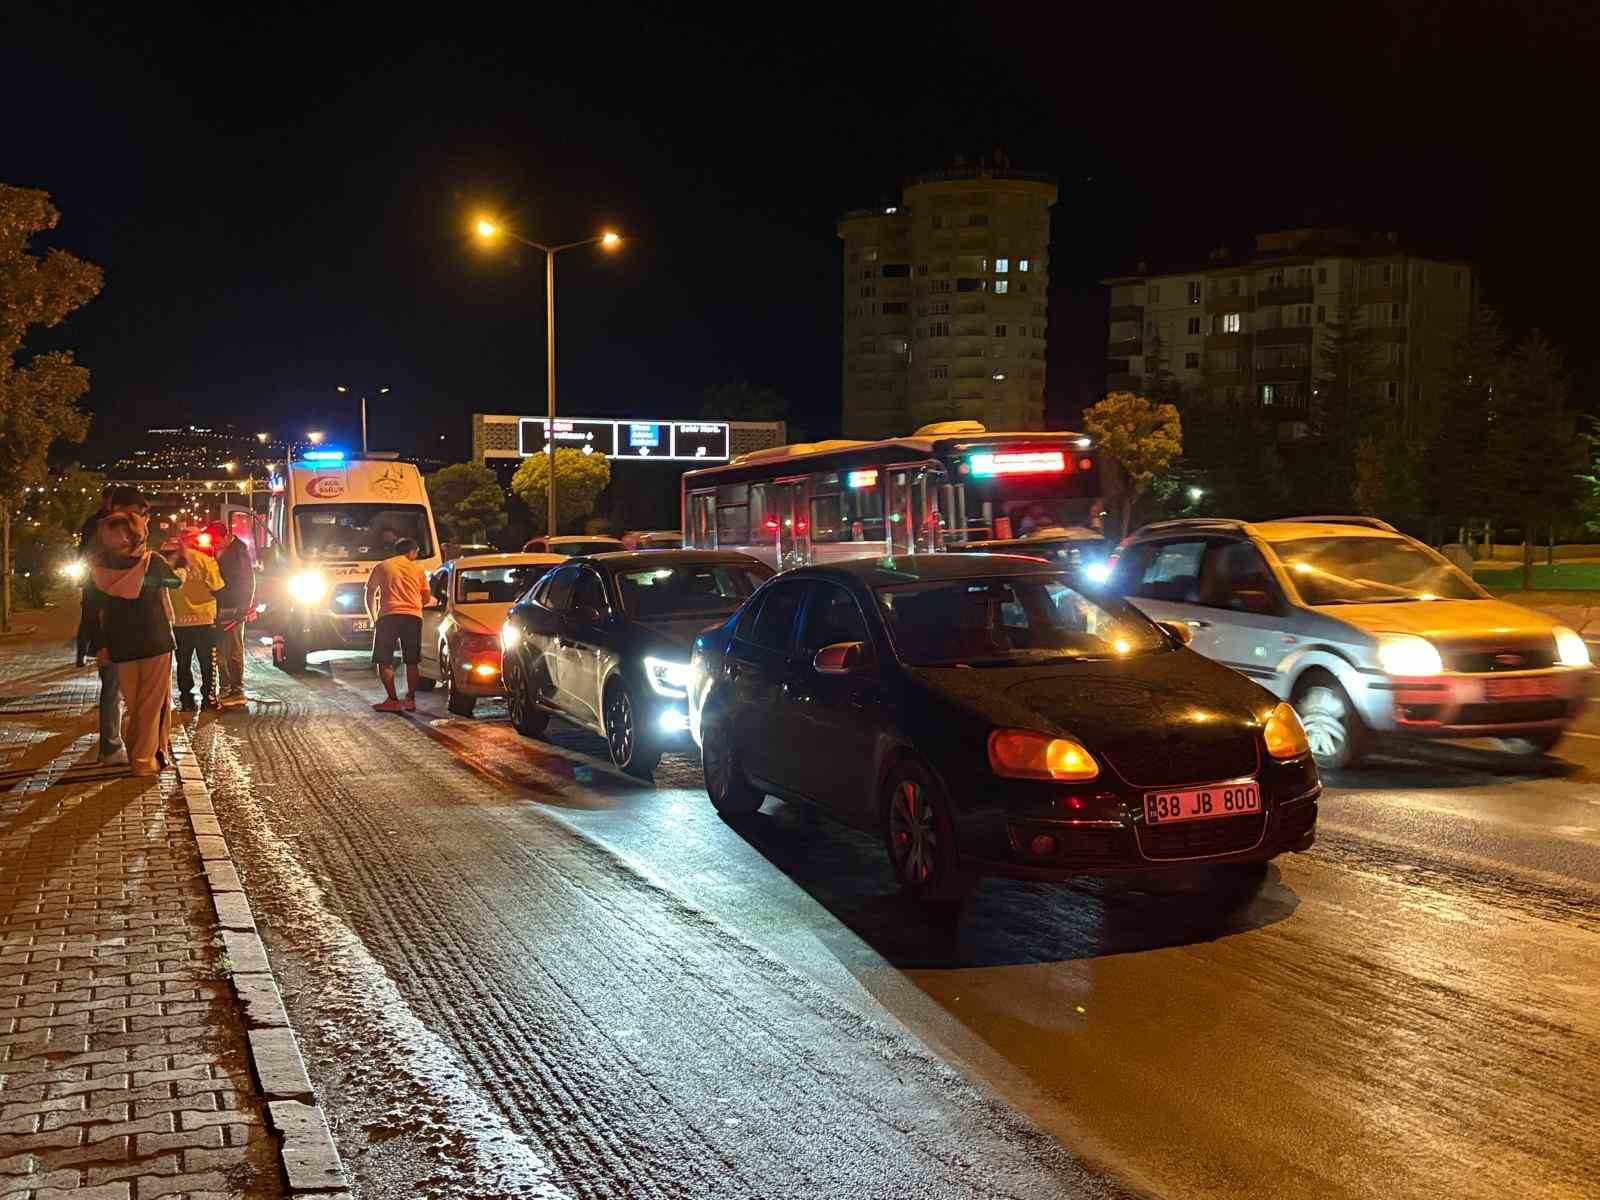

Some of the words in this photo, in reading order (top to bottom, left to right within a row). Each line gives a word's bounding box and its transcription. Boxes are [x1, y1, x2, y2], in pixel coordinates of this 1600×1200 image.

[1158, 796, 1180, 818] 38
[1191, 793, 1213, 815] JB
[1224, 788, 1257, 811] 800
